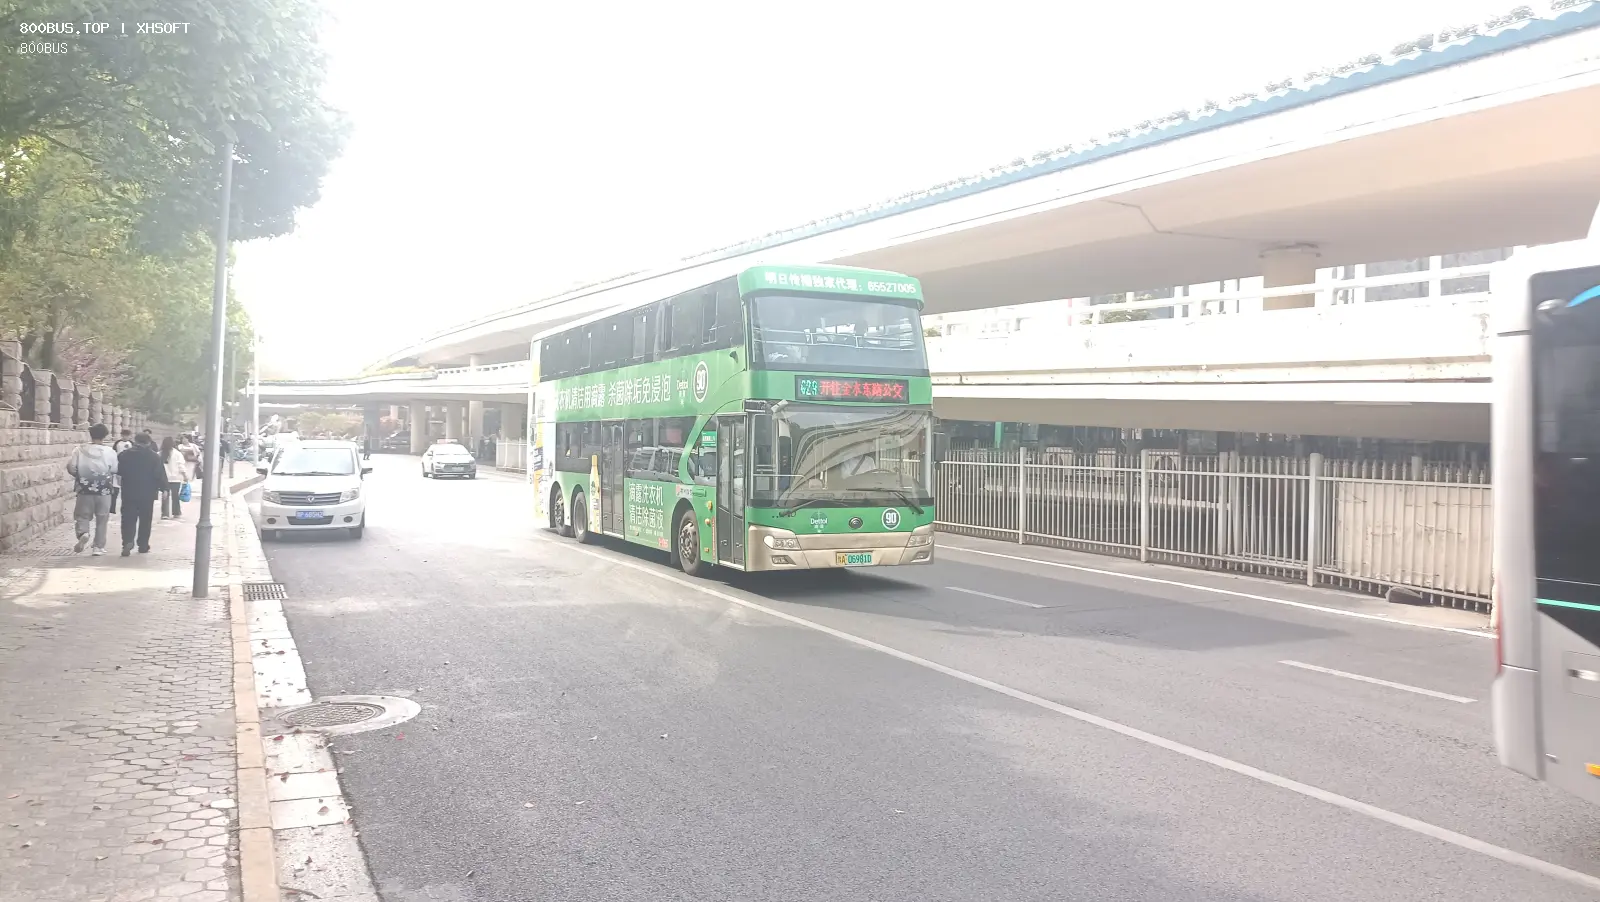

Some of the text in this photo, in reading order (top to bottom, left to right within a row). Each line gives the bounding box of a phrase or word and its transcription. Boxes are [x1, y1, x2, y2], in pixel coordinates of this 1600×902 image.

[608, 374, 671, 407] 杀菌除垢免浸泡
[696, 370, 706, 390] 90
[628, 482, 664, 507] 滴露洗衣机
[628, 504, 664, 530] 清洁除菌液
[885, 513, 897, 524] 90
